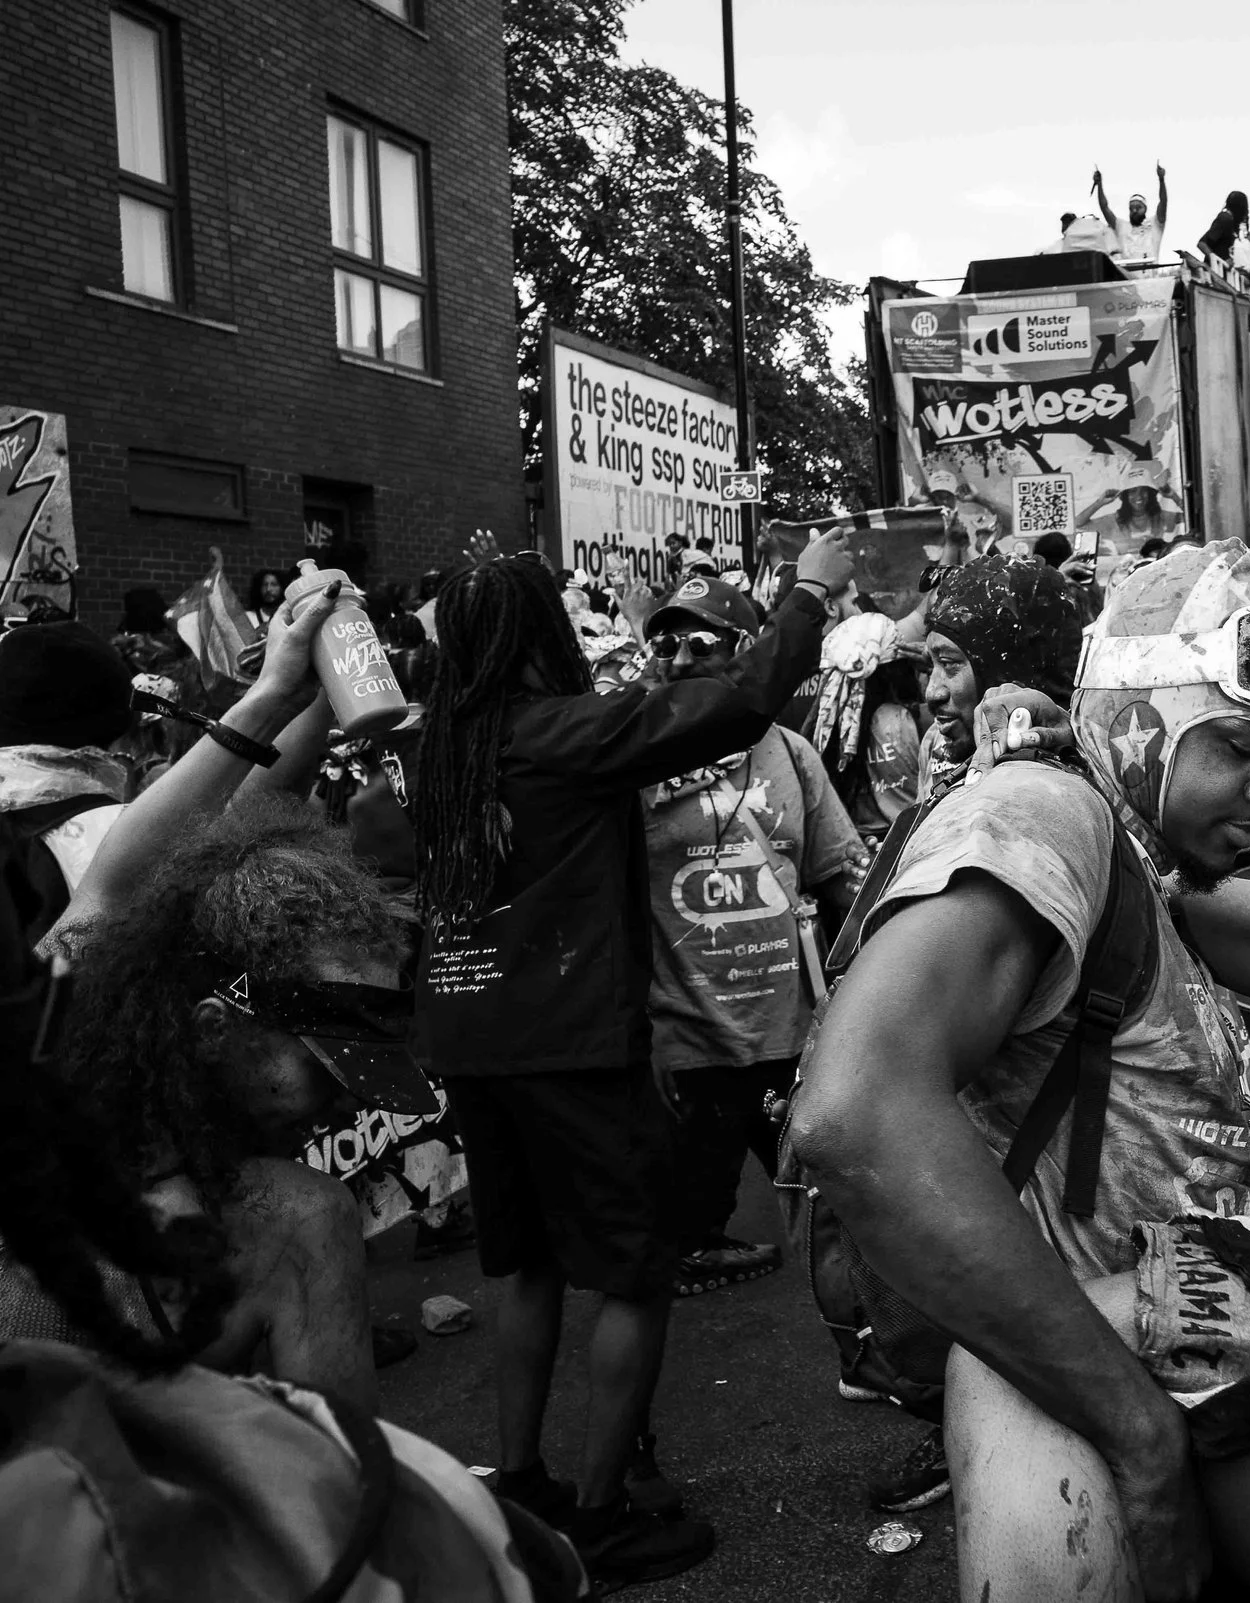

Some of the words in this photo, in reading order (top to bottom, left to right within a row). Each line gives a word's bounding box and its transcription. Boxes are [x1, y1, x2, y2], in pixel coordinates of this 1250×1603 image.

[1027, 315, 1072, 327] Master
[1027, 326, 1068, 340] Sound
[1027, 339, 1088, 352] Solutions
[568, 362, 607, 418] the
[611, 380, 678, 439] steeze
[569, 413, 588, 464] &
[597, 420, 644, 486] king
[651, 447, 686, 494] ssp
[748, 938, 790, 955] PLAYMAS
